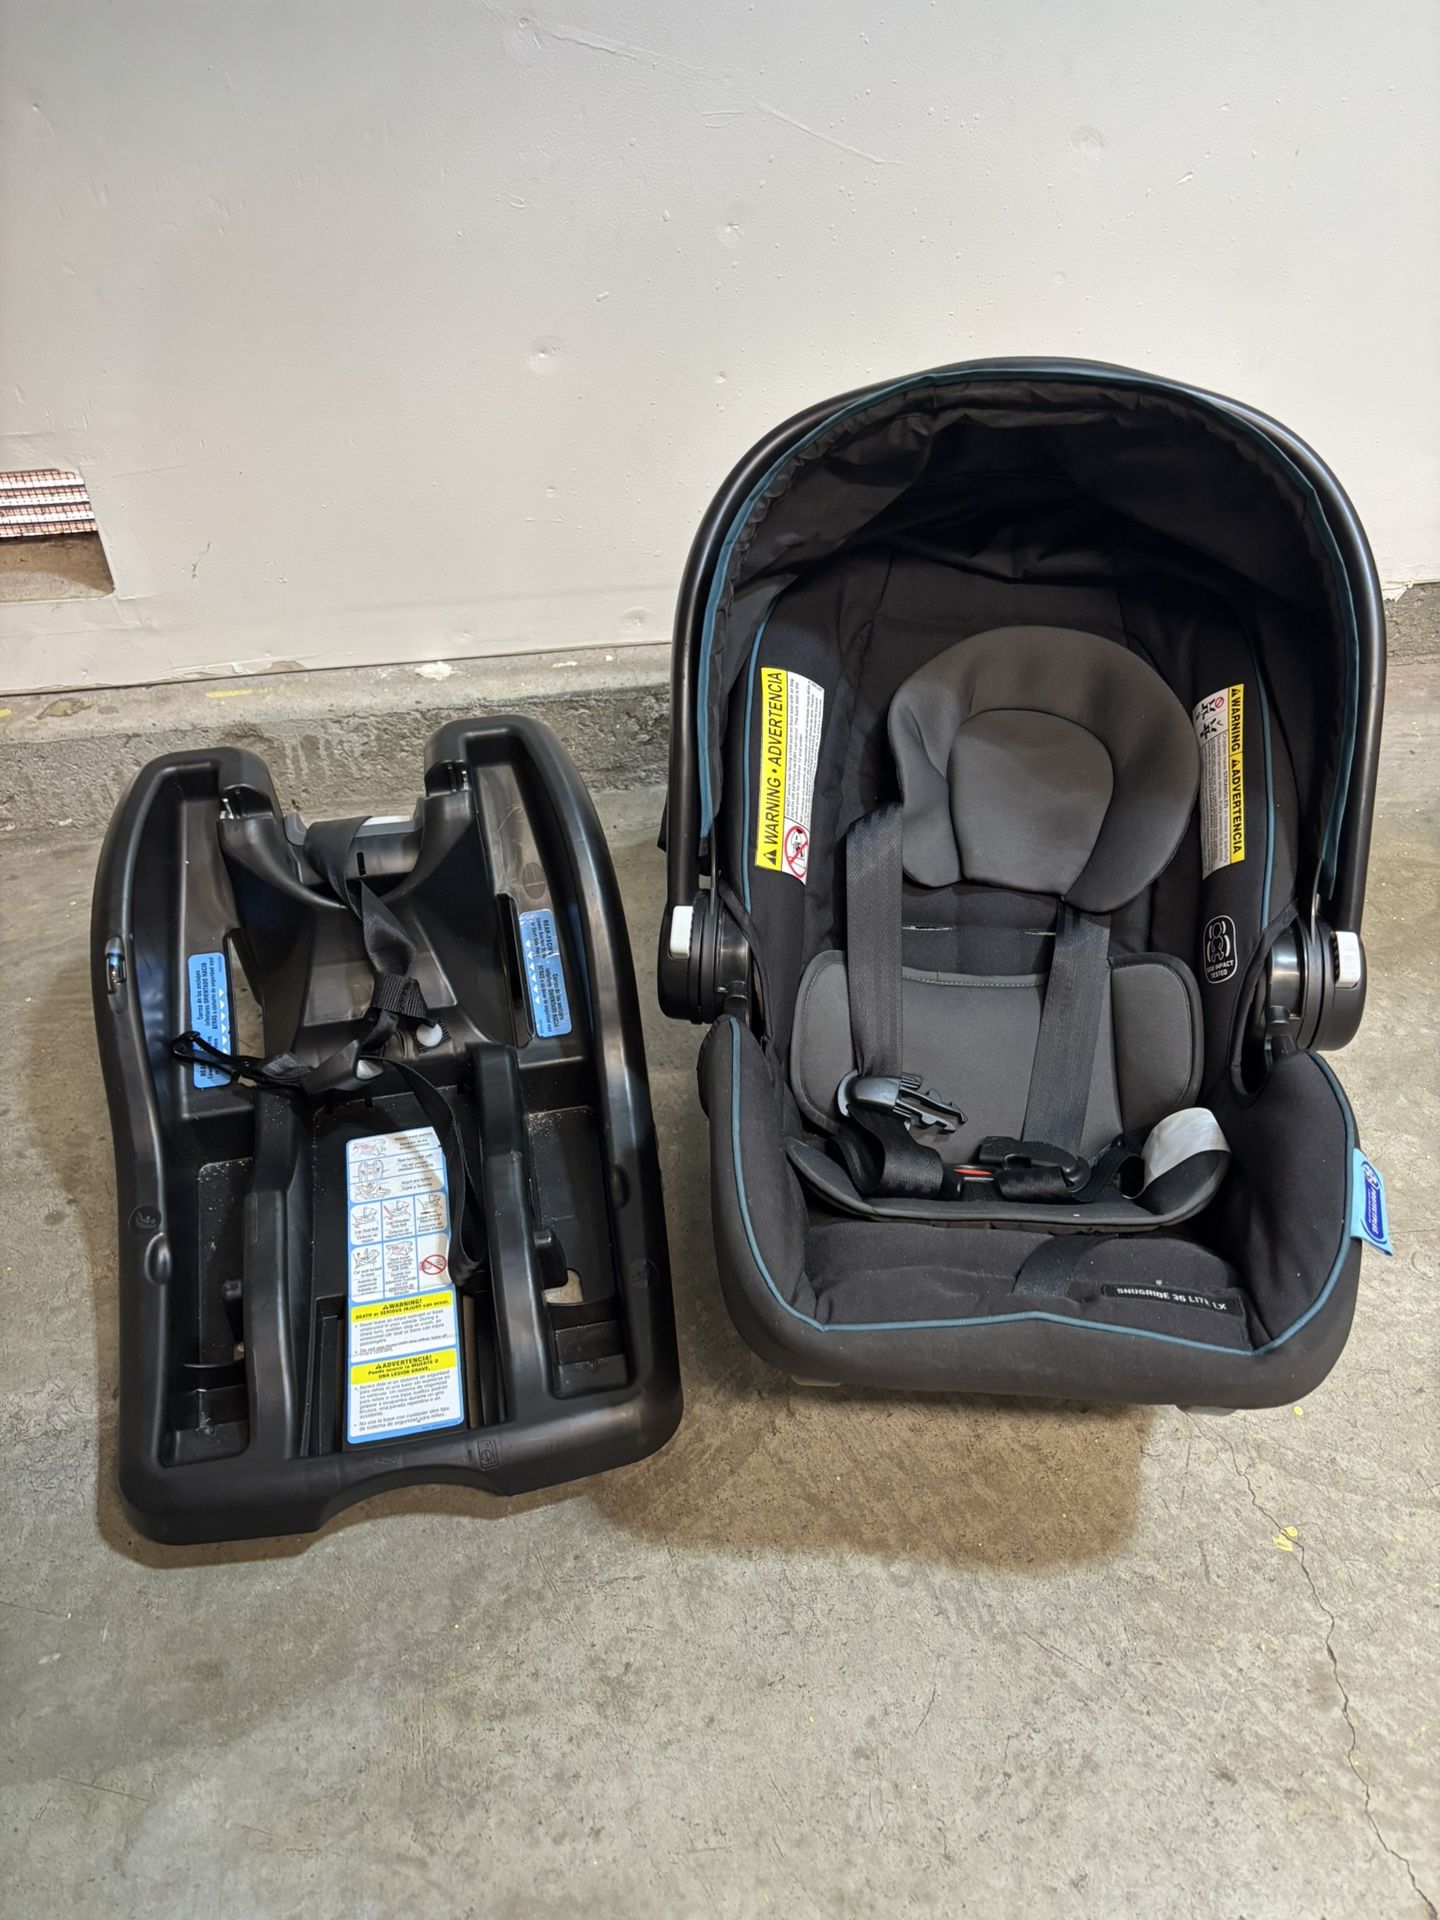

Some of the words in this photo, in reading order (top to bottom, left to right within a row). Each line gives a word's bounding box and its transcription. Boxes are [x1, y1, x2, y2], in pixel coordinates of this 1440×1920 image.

[768, 672, 782, 766] ADVERTENCIA
[1231, 697, 1241, 752] WARNING
[764, 774, 781, 847] WARNING
[1232, 770, 1242, 853] ADVERTENCIA
[389, 1299, 422, 1309] WARNING!
[1116, 1288, 1170, 1300] SNUGRIDE
[383, 1355, 432, 1368] ADVERTENCIA!
